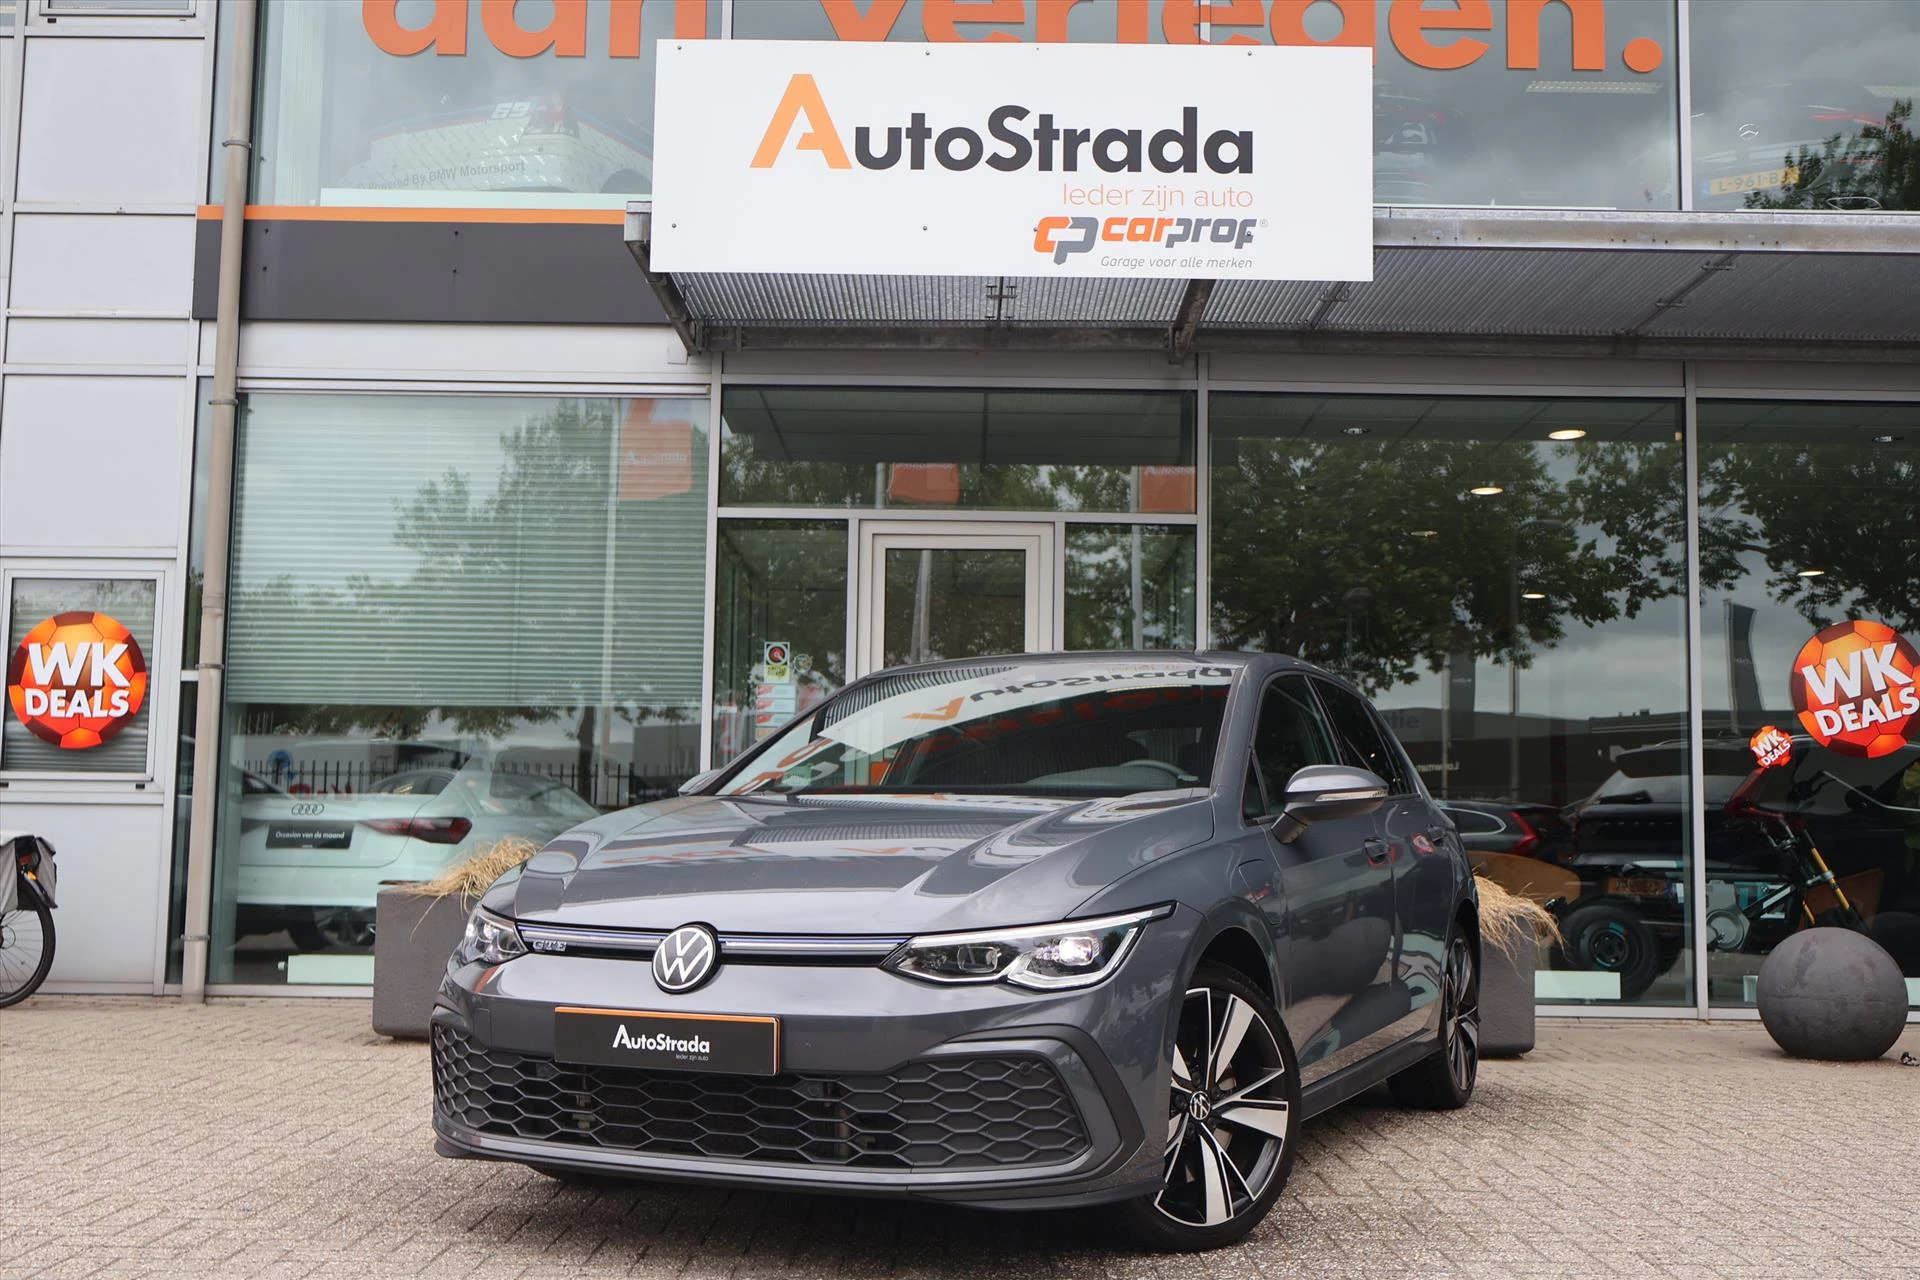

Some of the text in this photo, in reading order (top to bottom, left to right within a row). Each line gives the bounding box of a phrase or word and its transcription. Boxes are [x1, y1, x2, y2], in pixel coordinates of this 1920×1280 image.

[490, 101, 531, 120] 69
[749, 73, 1254, 175] AutoStrada
[412, 174, 427, 186] By
[429, 167, 458, 182] BMW
[459, 160, 526, 177] Motorsport
[1141, 185, 1186, 212] zijn
[1193, 187, 1254, 209] auto
[1101, 216, 1258, 250] carprof
[1100, 255, 1253, 270] Garage voor alle merken
[28, 641, 131, 687] WK
[1800, 642, 1915, 706] WK
[25, 688, 130, 719] DEALS
[1813, 686, 1920, 737] DEALS
[1751, 728, 1786, 757] WK
[1760, 741, 1792, 767] DEALS
[275, 829, 346, 840] Occasion van de maand
[532, 939, 567, 953] GTE
[612, 1024, 710, 1053] AutoStrada
